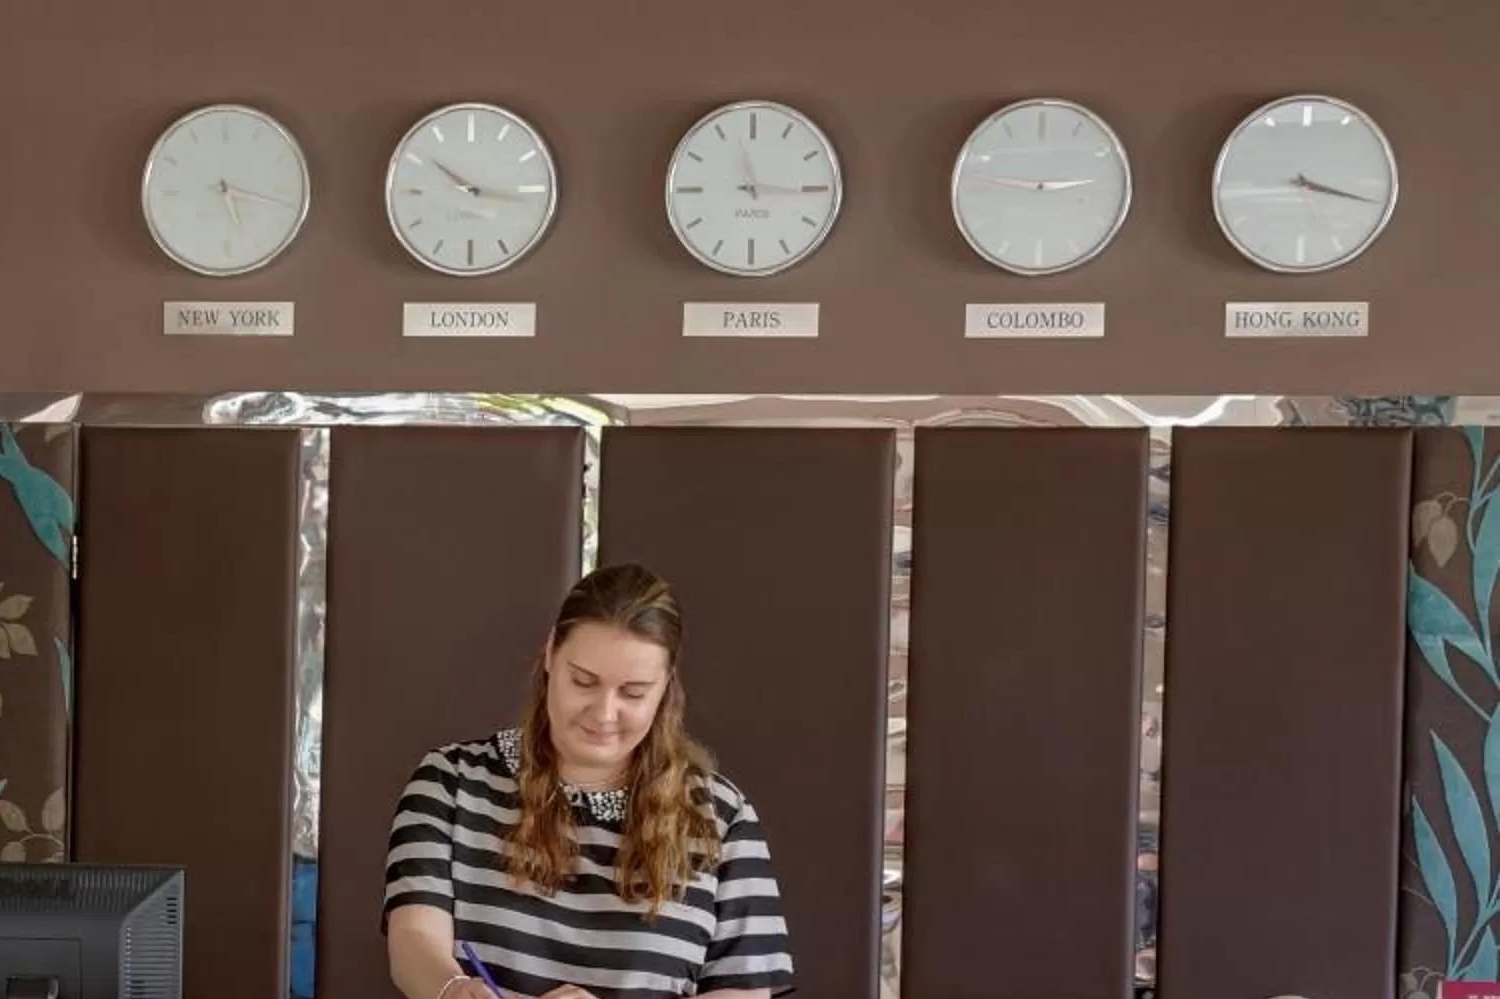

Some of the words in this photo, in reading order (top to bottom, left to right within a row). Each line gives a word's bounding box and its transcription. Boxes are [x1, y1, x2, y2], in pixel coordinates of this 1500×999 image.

[178, 309, 220, 327] NEW
[229, 310, 280, 327] YORK
[430, 310, 509, 328] LONDON
[723, 311, 782, 328] PARIS
[986, 311, 1085, 329] COLOMBO
[1234, 311, 1293, 329] HONG
[1302, 311, 1360, 328] KONG
